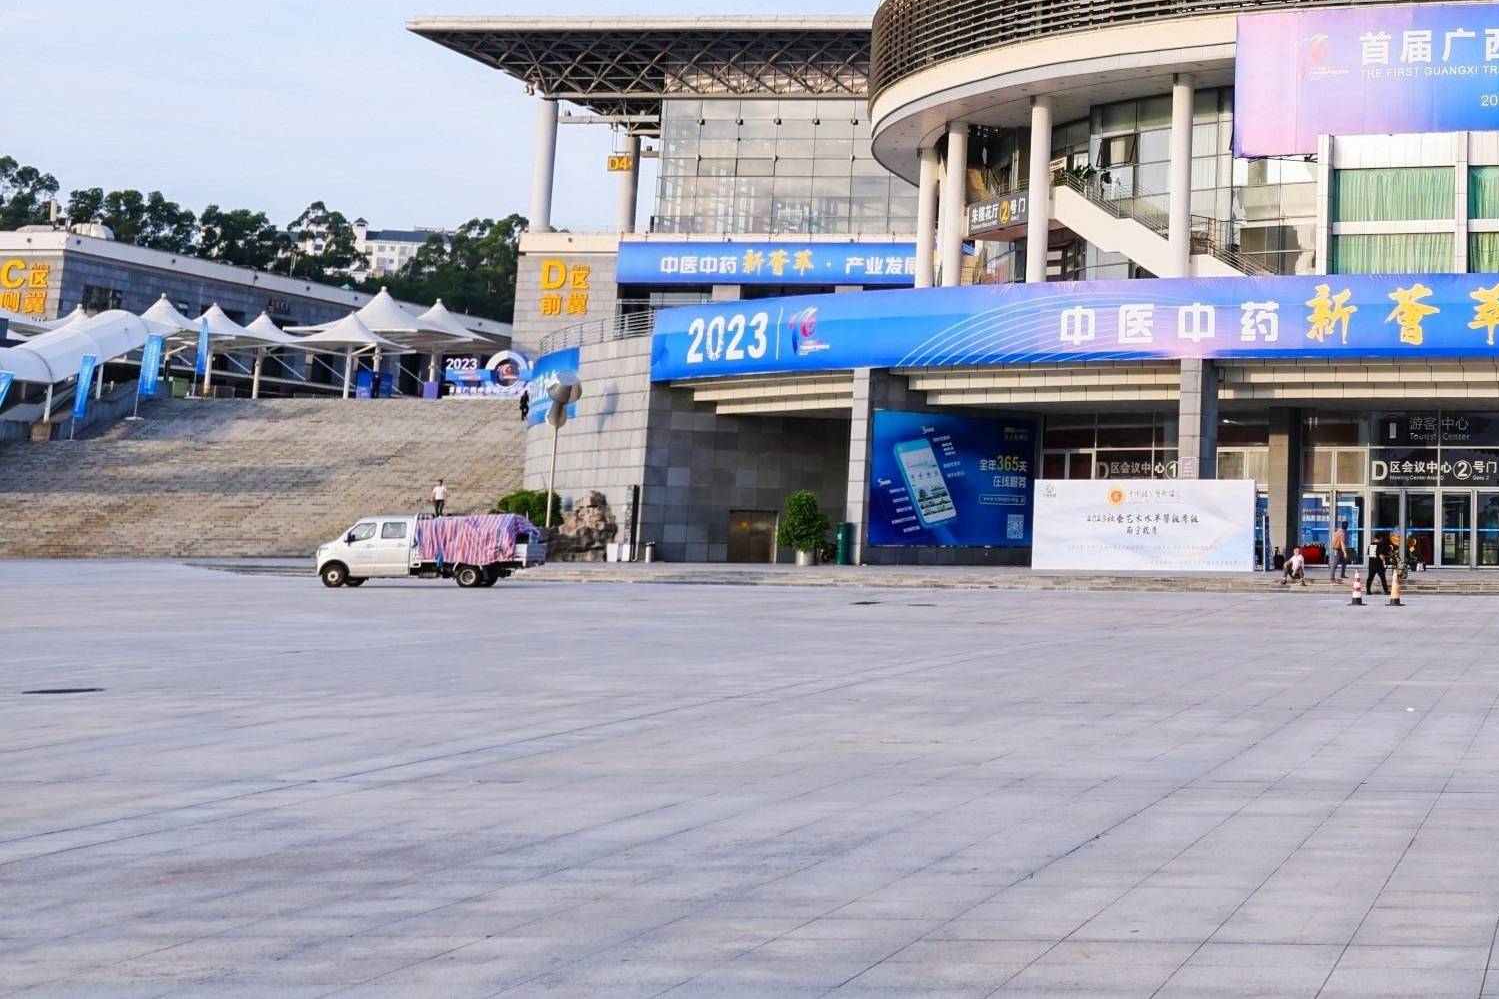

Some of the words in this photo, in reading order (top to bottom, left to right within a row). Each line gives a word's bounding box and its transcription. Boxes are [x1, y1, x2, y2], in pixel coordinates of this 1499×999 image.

[1360, 69, 1384, 79] THE
[1387, 67, 1419, 78] FIRST
[1424, 65, 1478, 76] GUANGXI
[608, 157, 628, 170] D4
[540, 294, 588, 316] 前翼
[685, 311, 769, 364] 2023
[446, 358, 477, 370] 2023
